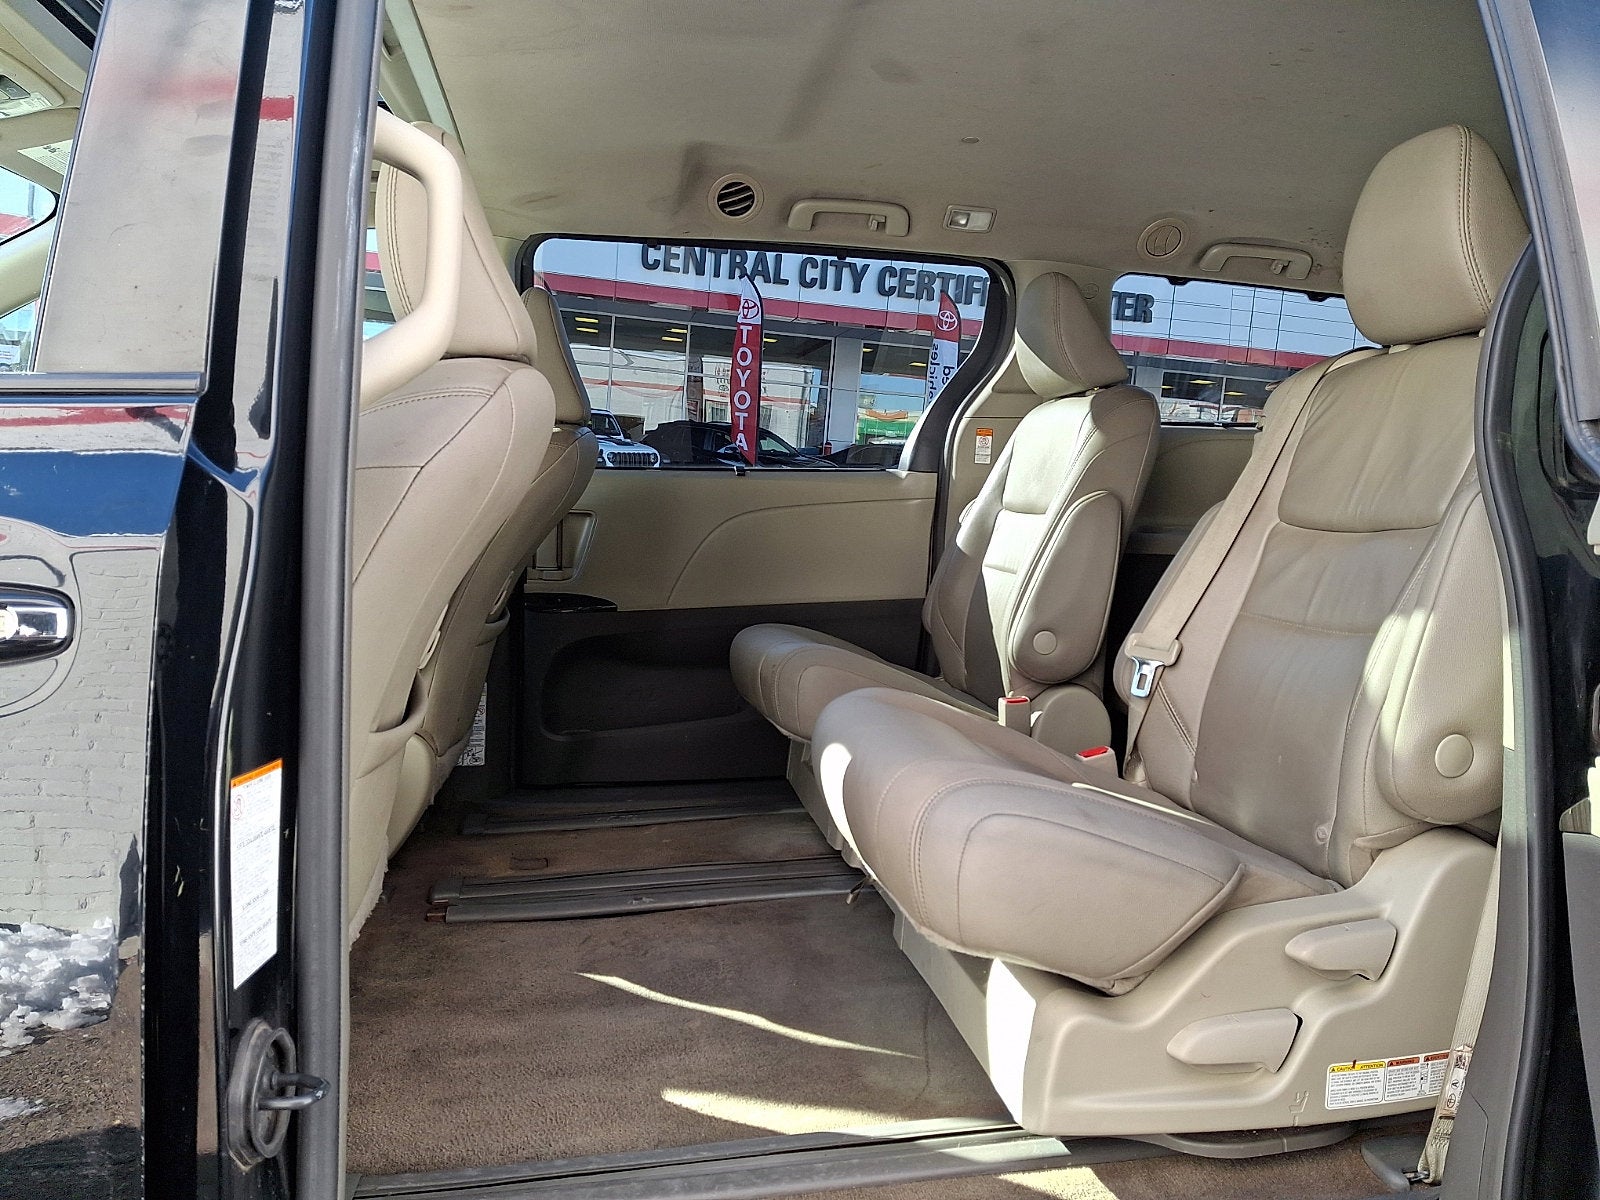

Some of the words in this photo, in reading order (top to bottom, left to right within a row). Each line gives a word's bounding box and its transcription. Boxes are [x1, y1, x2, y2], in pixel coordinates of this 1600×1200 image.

[641, 244, 789, 285] CENTRAL
[799, 256, 870, 293] CITY
[733, 325, 753, 451] TOYOTA
